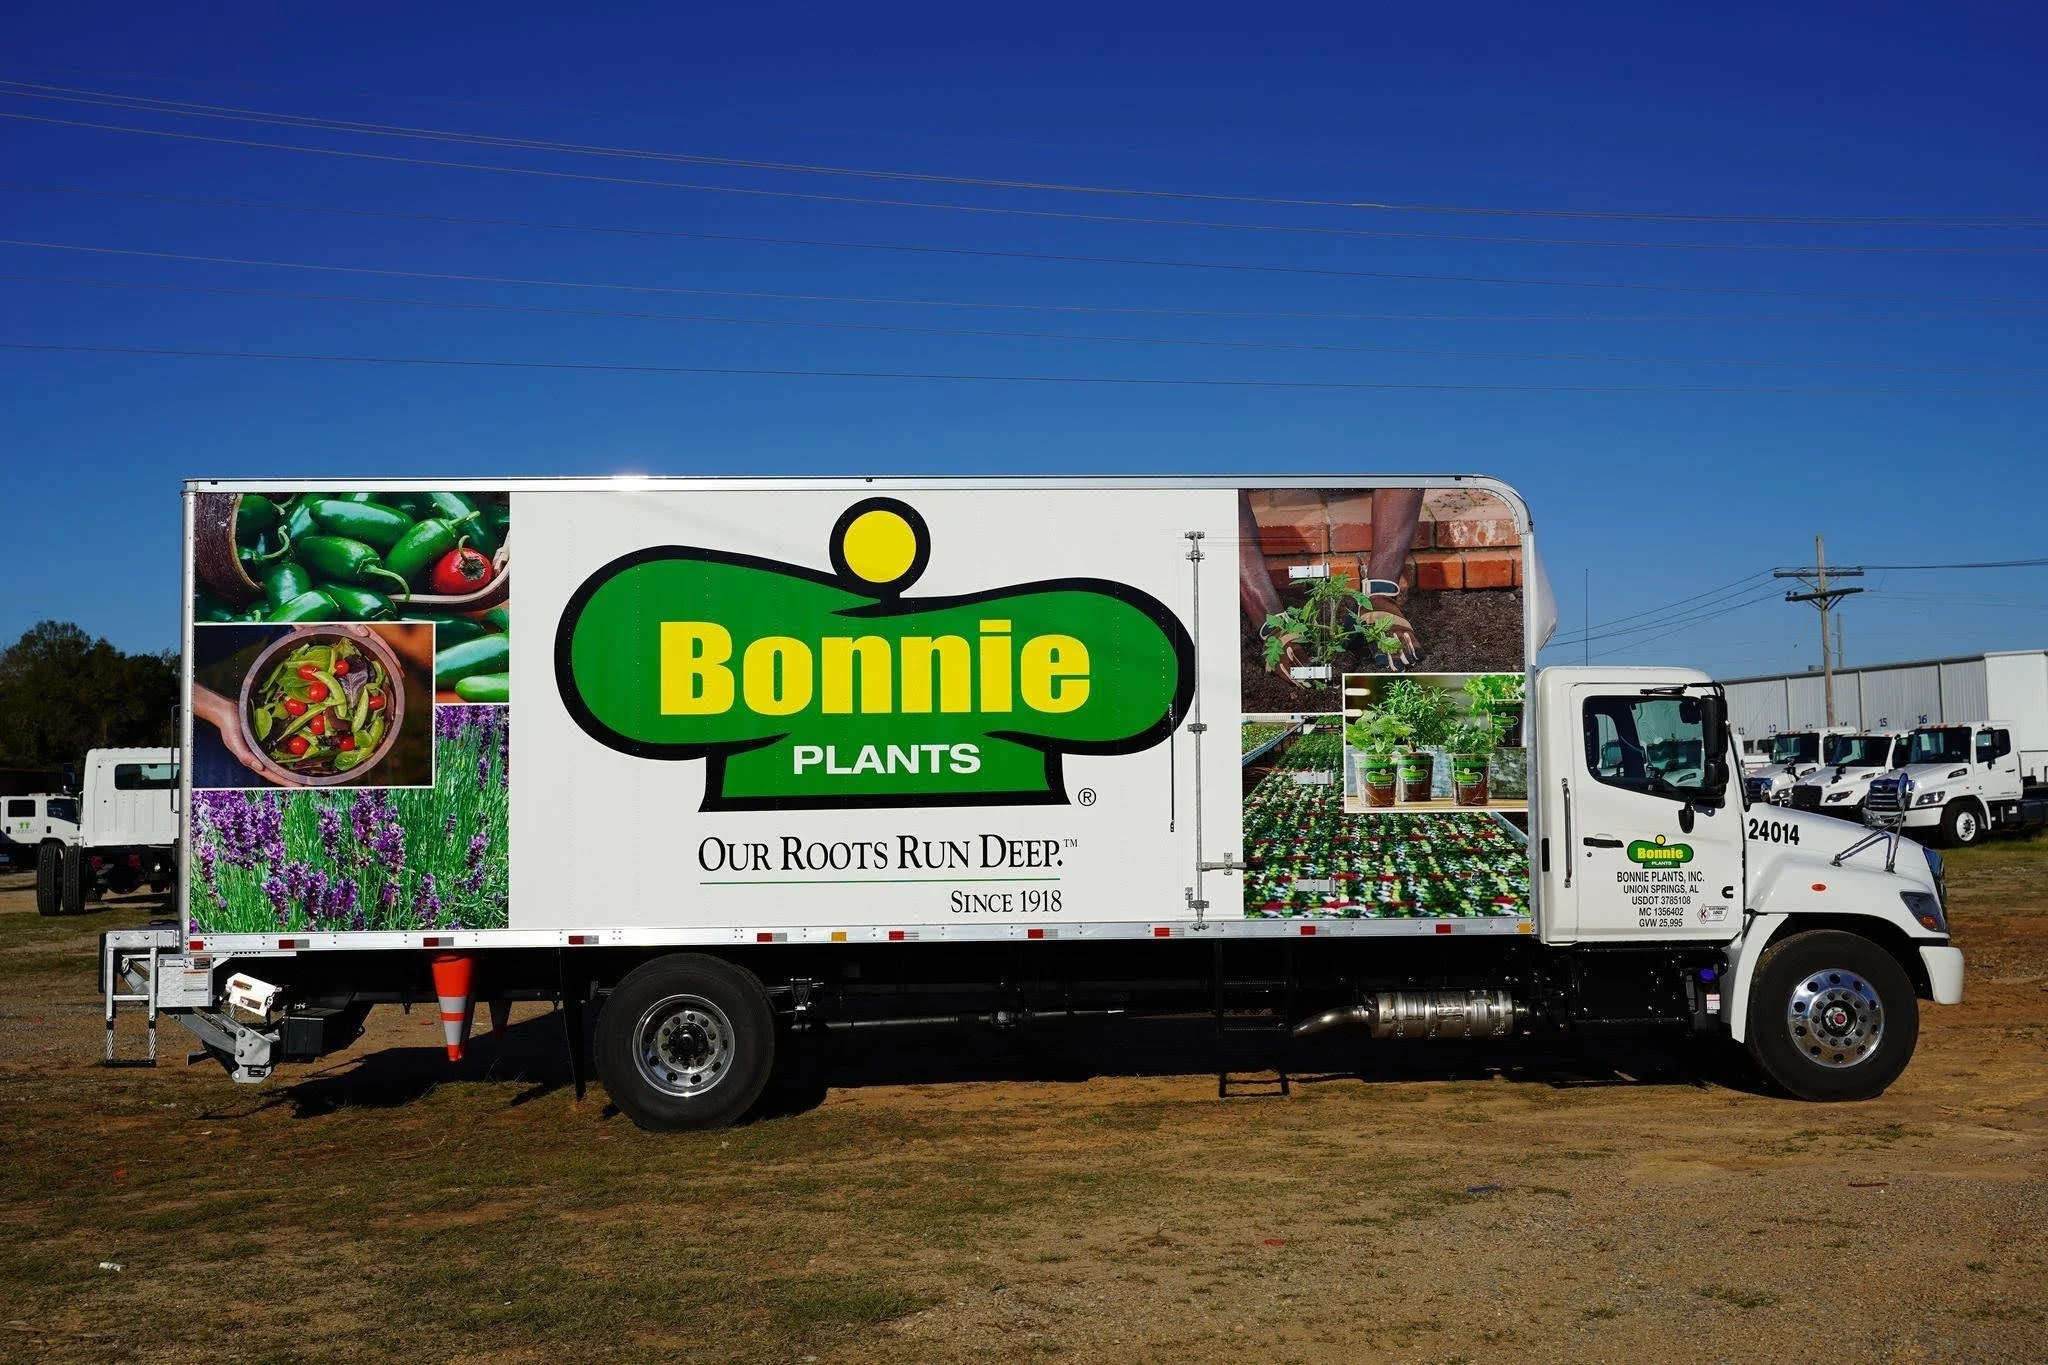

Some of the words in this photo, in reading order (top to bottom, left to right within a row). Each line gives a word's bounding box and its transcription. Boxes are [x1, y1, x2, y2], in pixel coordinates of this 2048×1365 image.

[660, 619, 1090, 716] Bonnie
[1879, 717, 1888, 728] 15
[1918, 714, 1928, 725] 16
[793, 743, 981, 775] PLANTS
[1748, 817, 1800, 846] 24014
[698, 836, 773, 872] OUR
[779, 836, 889, 872] ROOTS
[896, 834, 971, 870] RUN
[1637, 847, 1684, 859] Bonnie
[1616, 871, 1649, 882] BONNIE
[1651, 871, 1687, 884] PLANTS,
[1688, 871, 1705, 882] INC.
[1623, 885, 1649, 894] UNION
[1650, 884, 1688, 895] SPRINGS,
[1689, 884, 1699, 893] AL
[950, 890, 1014, 914] SINCE
[1019, 890, 1063, 913] 1918
[1631, 896, 1659, 905] USDOT
[1660, 896, 1692, 905] 3785108
[1639, 907, 1652, 916] MC
[1654, 907, 1684, 916] 1356402
[1638, 918, 1658, 928] GVW
[1658, 918, 1683, 928] 25,995
